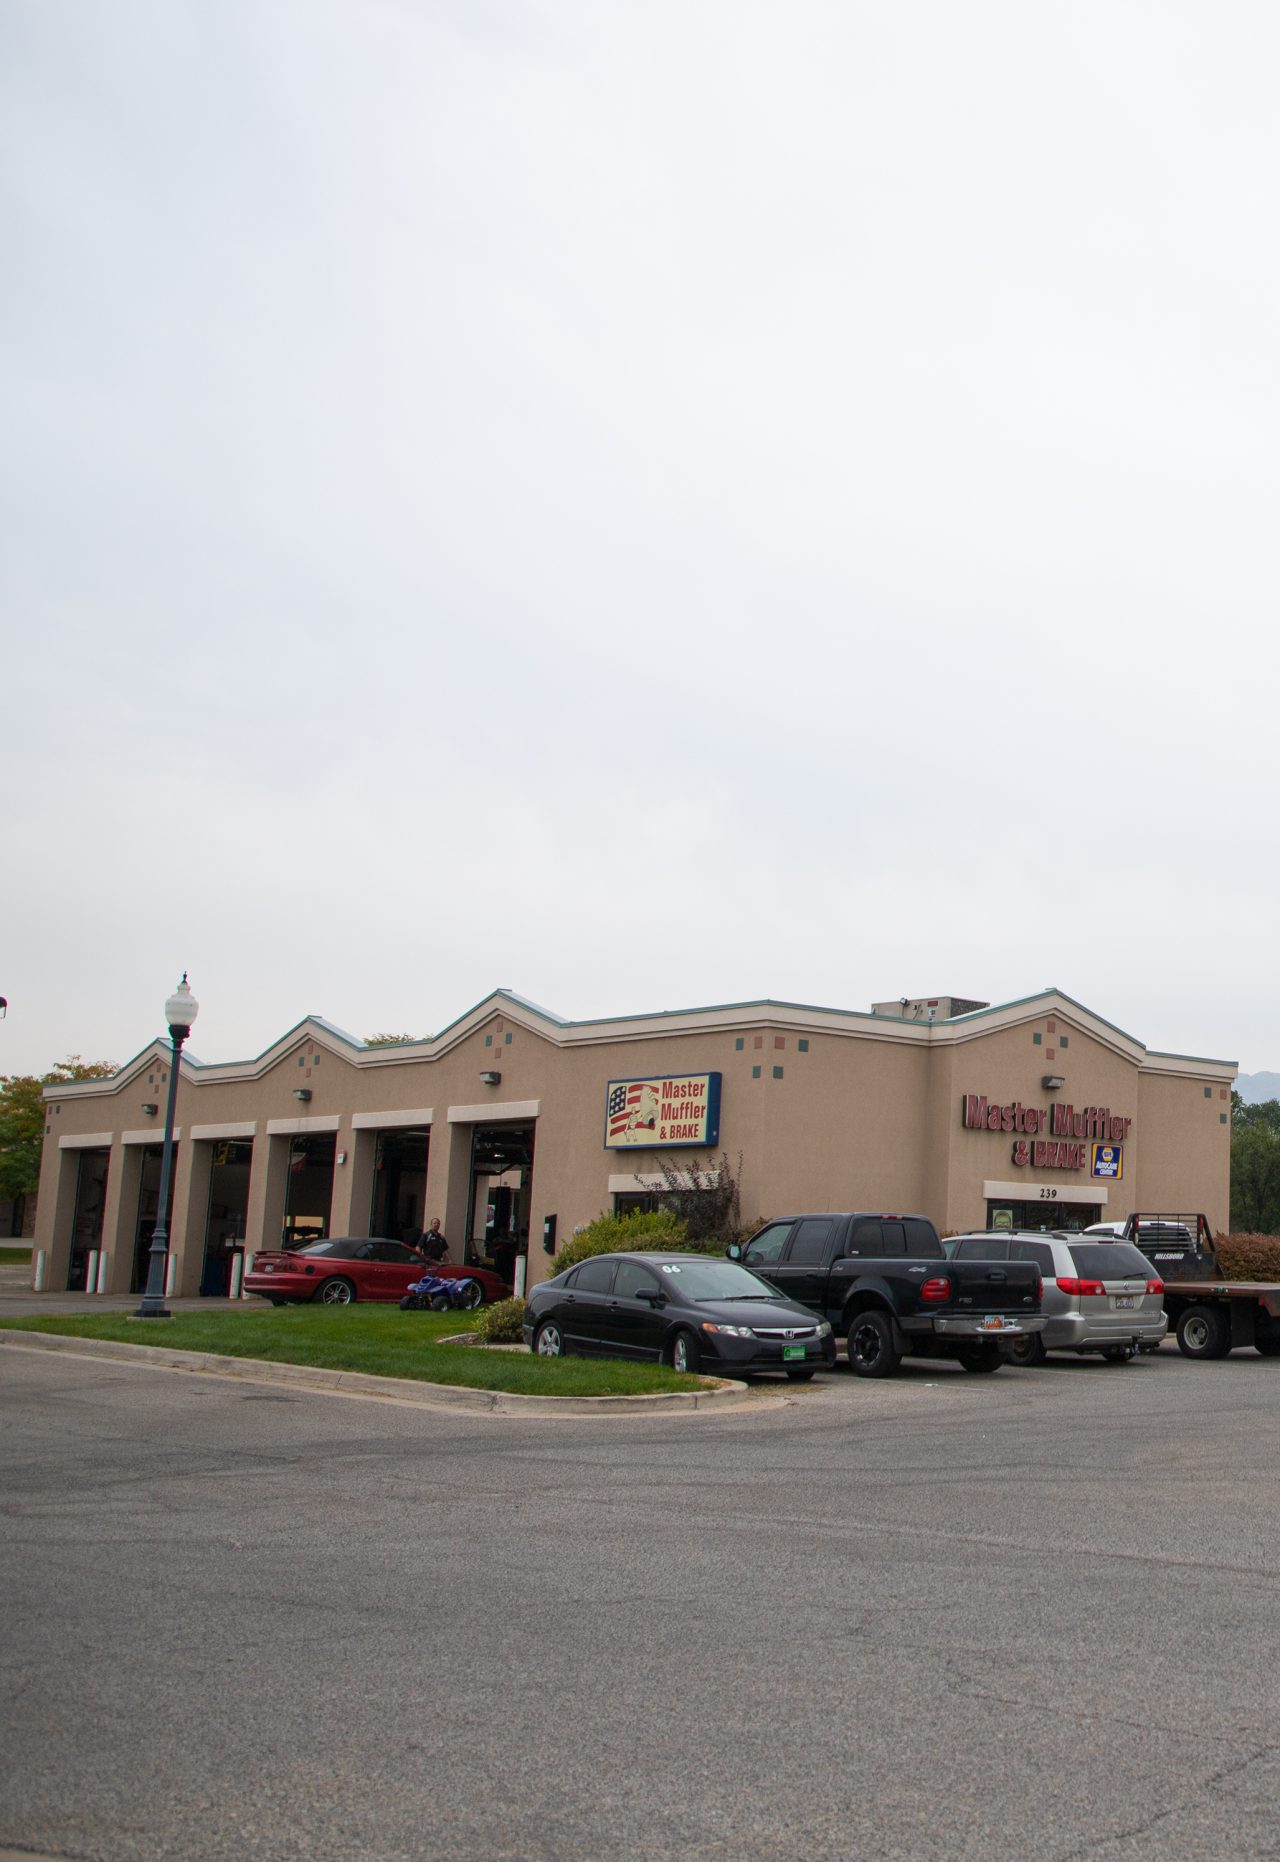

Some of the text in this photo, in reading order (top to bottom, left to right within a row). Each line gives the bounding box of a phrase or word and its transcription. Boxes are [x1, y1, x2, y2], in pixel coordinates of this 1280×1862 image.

[661, 1081, 705, 1099] Master
[660, 1101, 706, 1121] Muffler
[963, 1094, 1132, 1140] Master Muffler
[659, 1123, 699, 1139] & BRAKE
[1012, 1140, 1086, 1169] & BRAKE
[1040, 1188, 1057, 1199] 239
[662, 1265, 681, 1273] 06
